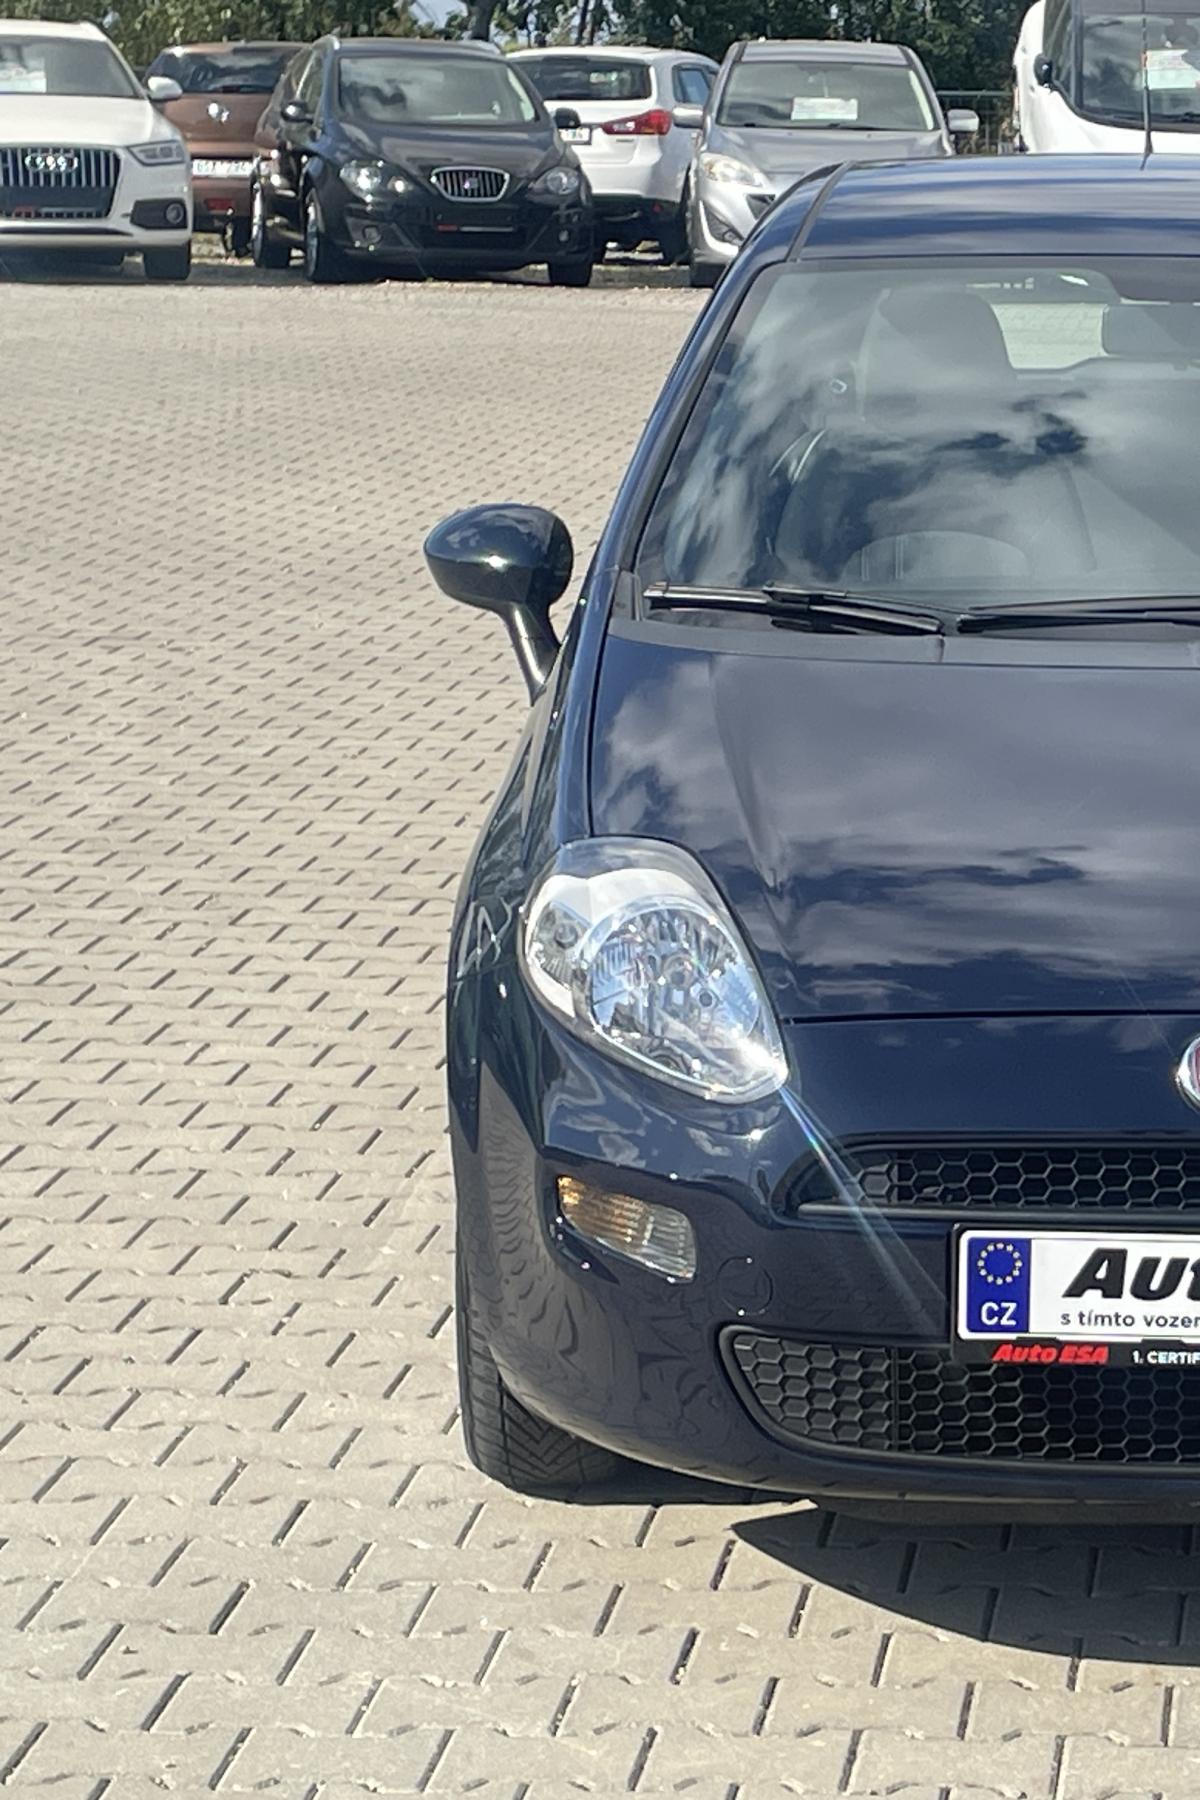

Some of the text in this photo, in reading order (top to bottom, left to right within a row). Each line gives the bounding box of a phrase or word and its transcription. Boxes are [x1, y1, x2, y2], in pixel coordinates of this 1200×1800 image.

[980, 1301, 1017, 1326] CZ
[1061, 1313, 1071, 1325] s
[1078, 1310, 1135, 1327] tímto
[992, 1343, 1109, 1365] Auto ESA
[1133, 1351, 1144, 1364] 1.
